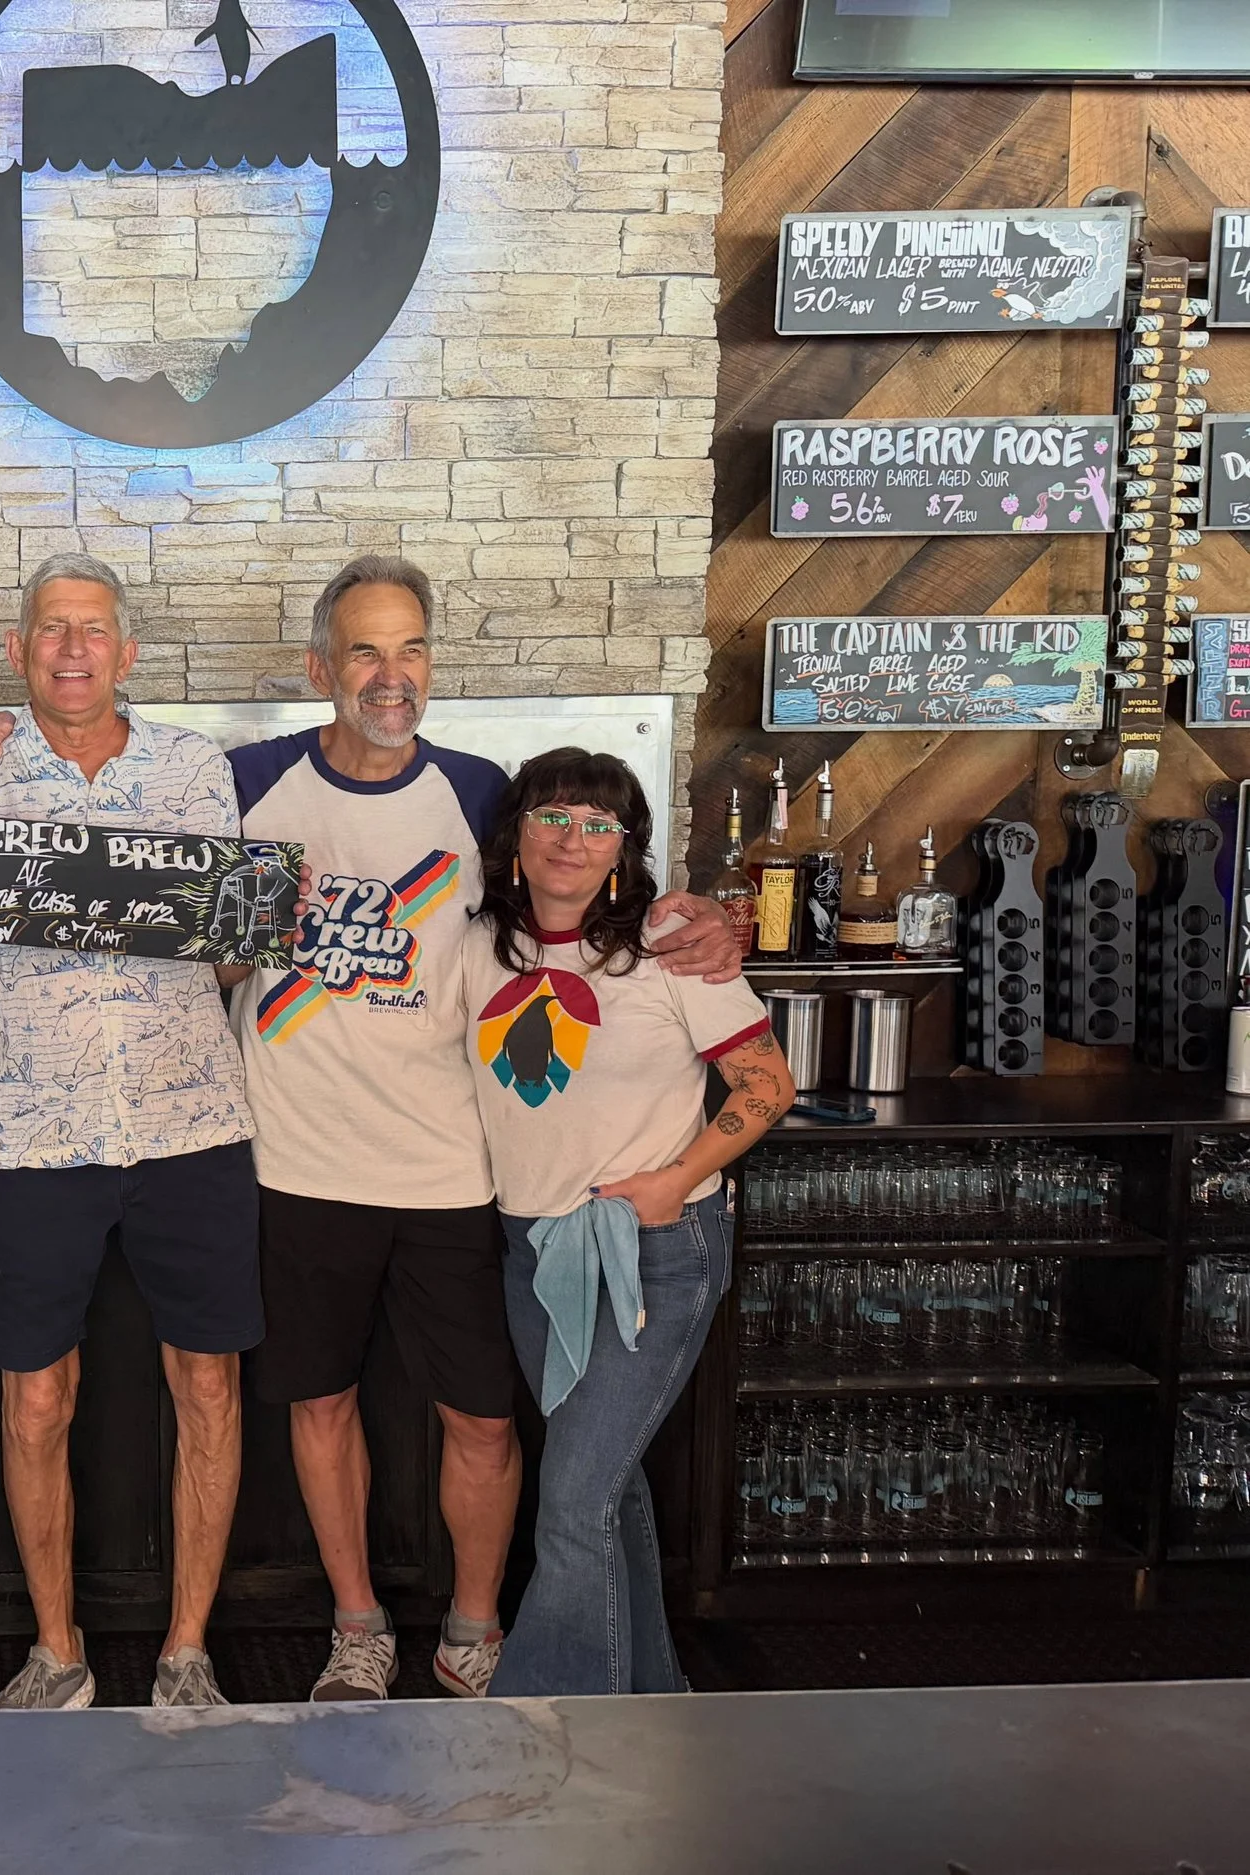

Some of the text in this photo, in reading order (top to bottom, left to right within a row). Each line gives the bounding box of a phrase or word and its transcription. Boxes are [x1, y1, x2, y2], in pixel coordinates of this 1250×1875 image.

[791, 222, 883, 257] SPEEDY
[792, 257, 1094, 280] MEXICAN LAGER BREWED WITH AGAVE NECTAR
[794, 286, 853, 314] 5.0%
[849, 299, 875, 315] ABV
[947, 301, 980, 314] PINT
[1105, 316, 1114, 327] 7
[782, 426, 1088, 468] RASPBERRY ROSÉ
[782, 470, 1010, 488] RED RASPBERRY BARREL AGED SOUR
[830, 492, 885, 525] 5.6%
[874, 513, 892, 523] ABV
[954, 511, 978, 523] TEKU
[777, 622, 1080, 655] THE CAPTAIN & THE KID
[793, 654, 967, 674] TEQUILA BARREL AGED
[811, 674, 975, 694] SALTED LIME GOSE
[876, 707, 897, 723] ABV
[107, 836, 213, 873] BREW
[15, 859, 54, 887] ALE
[764, 876, 794, 884] TAYLOR
[28, 890, 78, 914] CLASS
[87, 899, 111, 917] OF
[94, 929, 126, 947] PINT
[314, 947, 403, 985] Brew
[366, 990, 427, 1009] Birdfish
